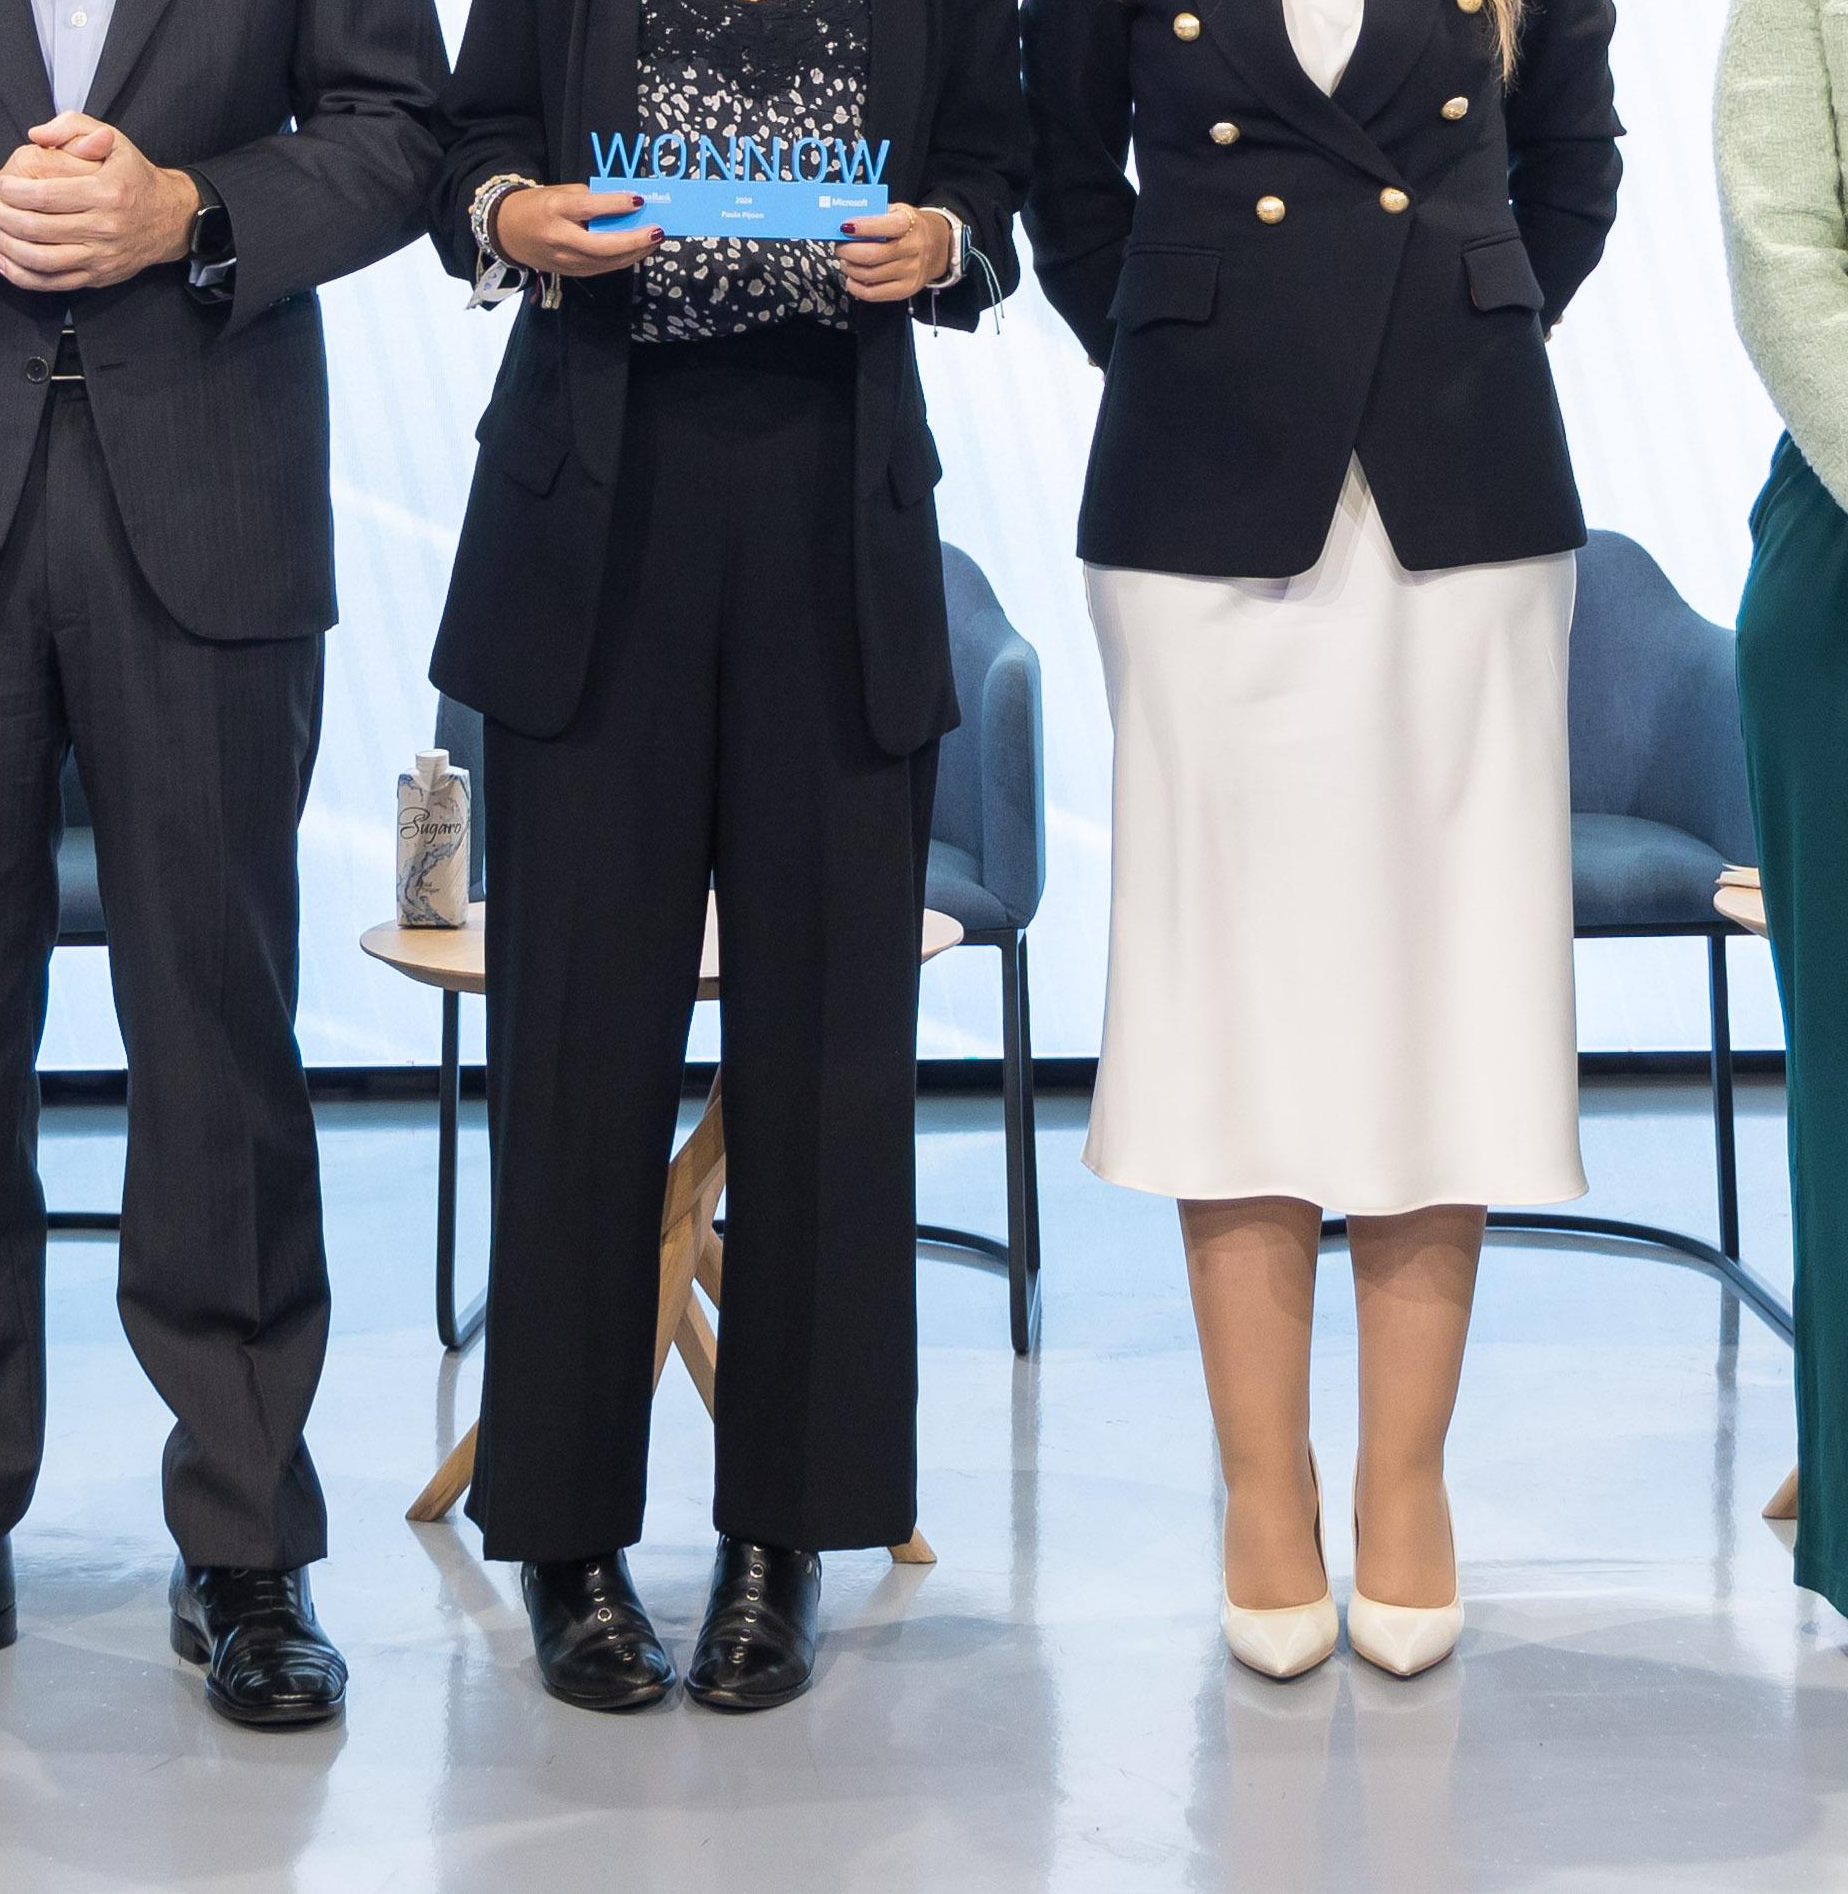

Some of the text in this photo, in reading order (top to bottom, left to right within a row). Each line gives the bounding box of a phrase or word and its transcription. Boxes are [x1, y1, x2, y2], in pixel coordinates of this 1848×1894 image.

[591, 131, 891, 184] WONNOW
[832, 197, 869, 207] Microsoft
[398, 806, 461, 844] Sugaro
